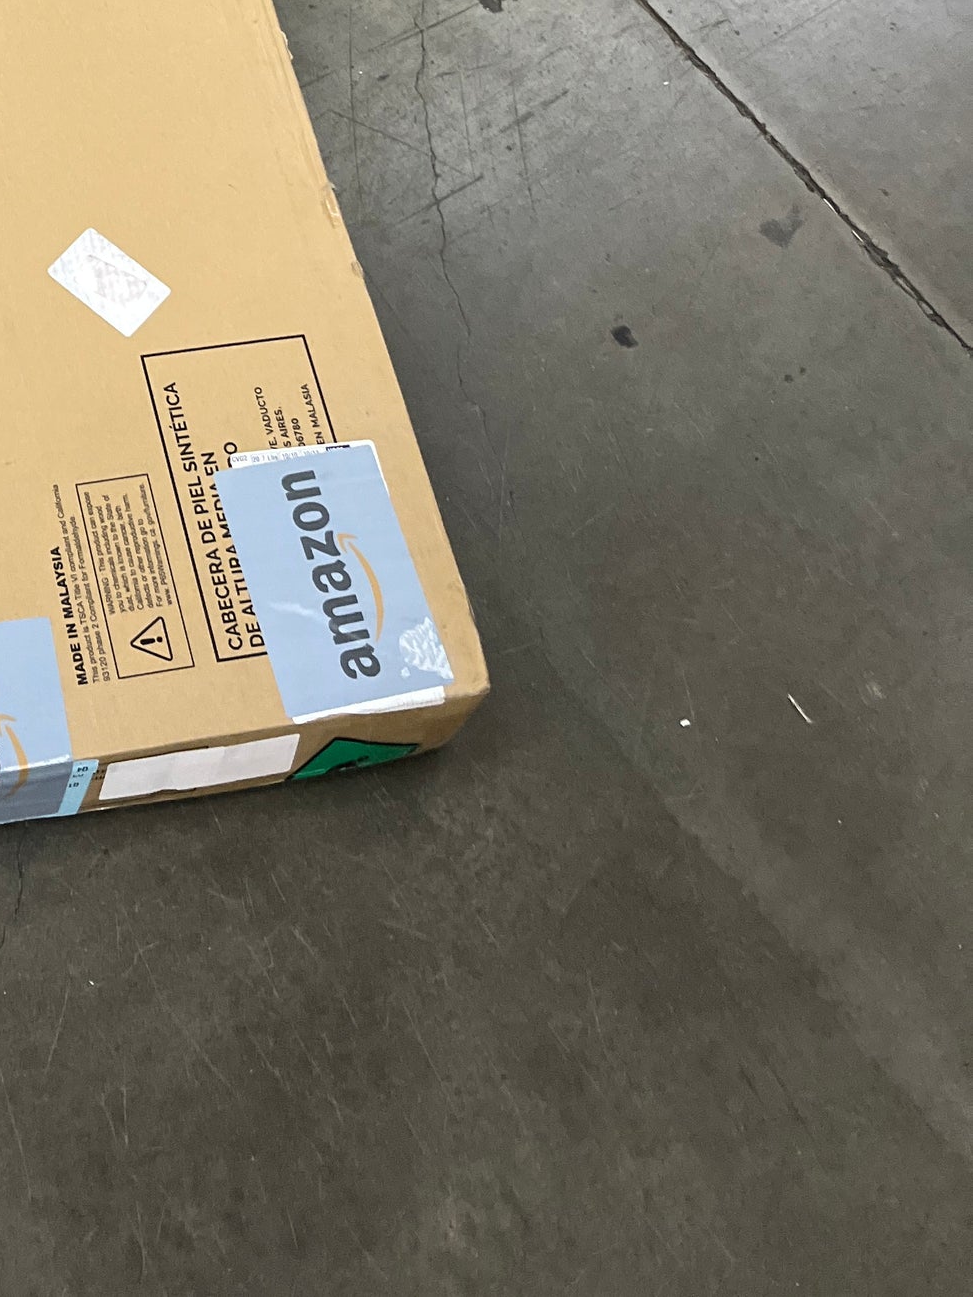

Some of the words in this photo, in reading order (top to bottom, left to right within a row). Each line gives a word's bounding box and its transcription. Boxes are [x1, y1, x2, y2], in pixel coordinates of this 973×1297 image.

[254, 386, 274, 436] VADUCTO
[300, 384, 320, 428] MALASIA
[163, 382, 198, 472] SINTÉTICA
[314, 431, 326, 444] EN
[200, 452, 219, 476] EN
[51, 483, 64, 518] California
[83, 491, 94, 515] expose
[188, 476, 209, 514] PIEL
[88, 516, 97, 529] can
[95, 505, 105, 523] wood
[103, 502, 114, 520] State
[114, 505, 123, 520] birth
[59, 520, 68, 534] and
[108, 521, 116, 532] the
[126, 512, 142, 554] reproductive
[139, 526, 147, 535] go
[197, 518, 216, 544] DE
[91, 529, 104, 556] product
[99, 524, 113, 554] including
[62, 535, 77, 572] compliant
[96, 556, 106, 571] This
[113, 541, 124, 564] known
[124, 546, 134, 567] cause
[136, 555, 145, 573] other
[141, 536, 155, 574] information
[50, 545, 74, 618] MALAYSIA
[70, 573, 78, 582] VI
[80, 570, 88, 581] for
[106, 556, 120, 590] chemicals
[120, 573, 130, 592] which
[150, 575, 159, 593] more
[281, 470, 381, 680] amazon
[72, 583, 82, 599] Title
[83, 582, 98, 621] Compliant
[130, 577, 144, 610] California
[142, 583, 154, 608] defects
[154, 594, 163, 606] For
[206, 548, 242, 650] CABECERA
[76, 601, 87, 624] TSCA
[117, 599, 126, 612] you
[66, 622, 78, 639] IN
[93, 630, 105, 654] phase
[246, 621, 266, 648] DE
[83, 633, 97, 664] product
[70, 642, 88, 685] MADE
[90, 666, 100, 682] This
